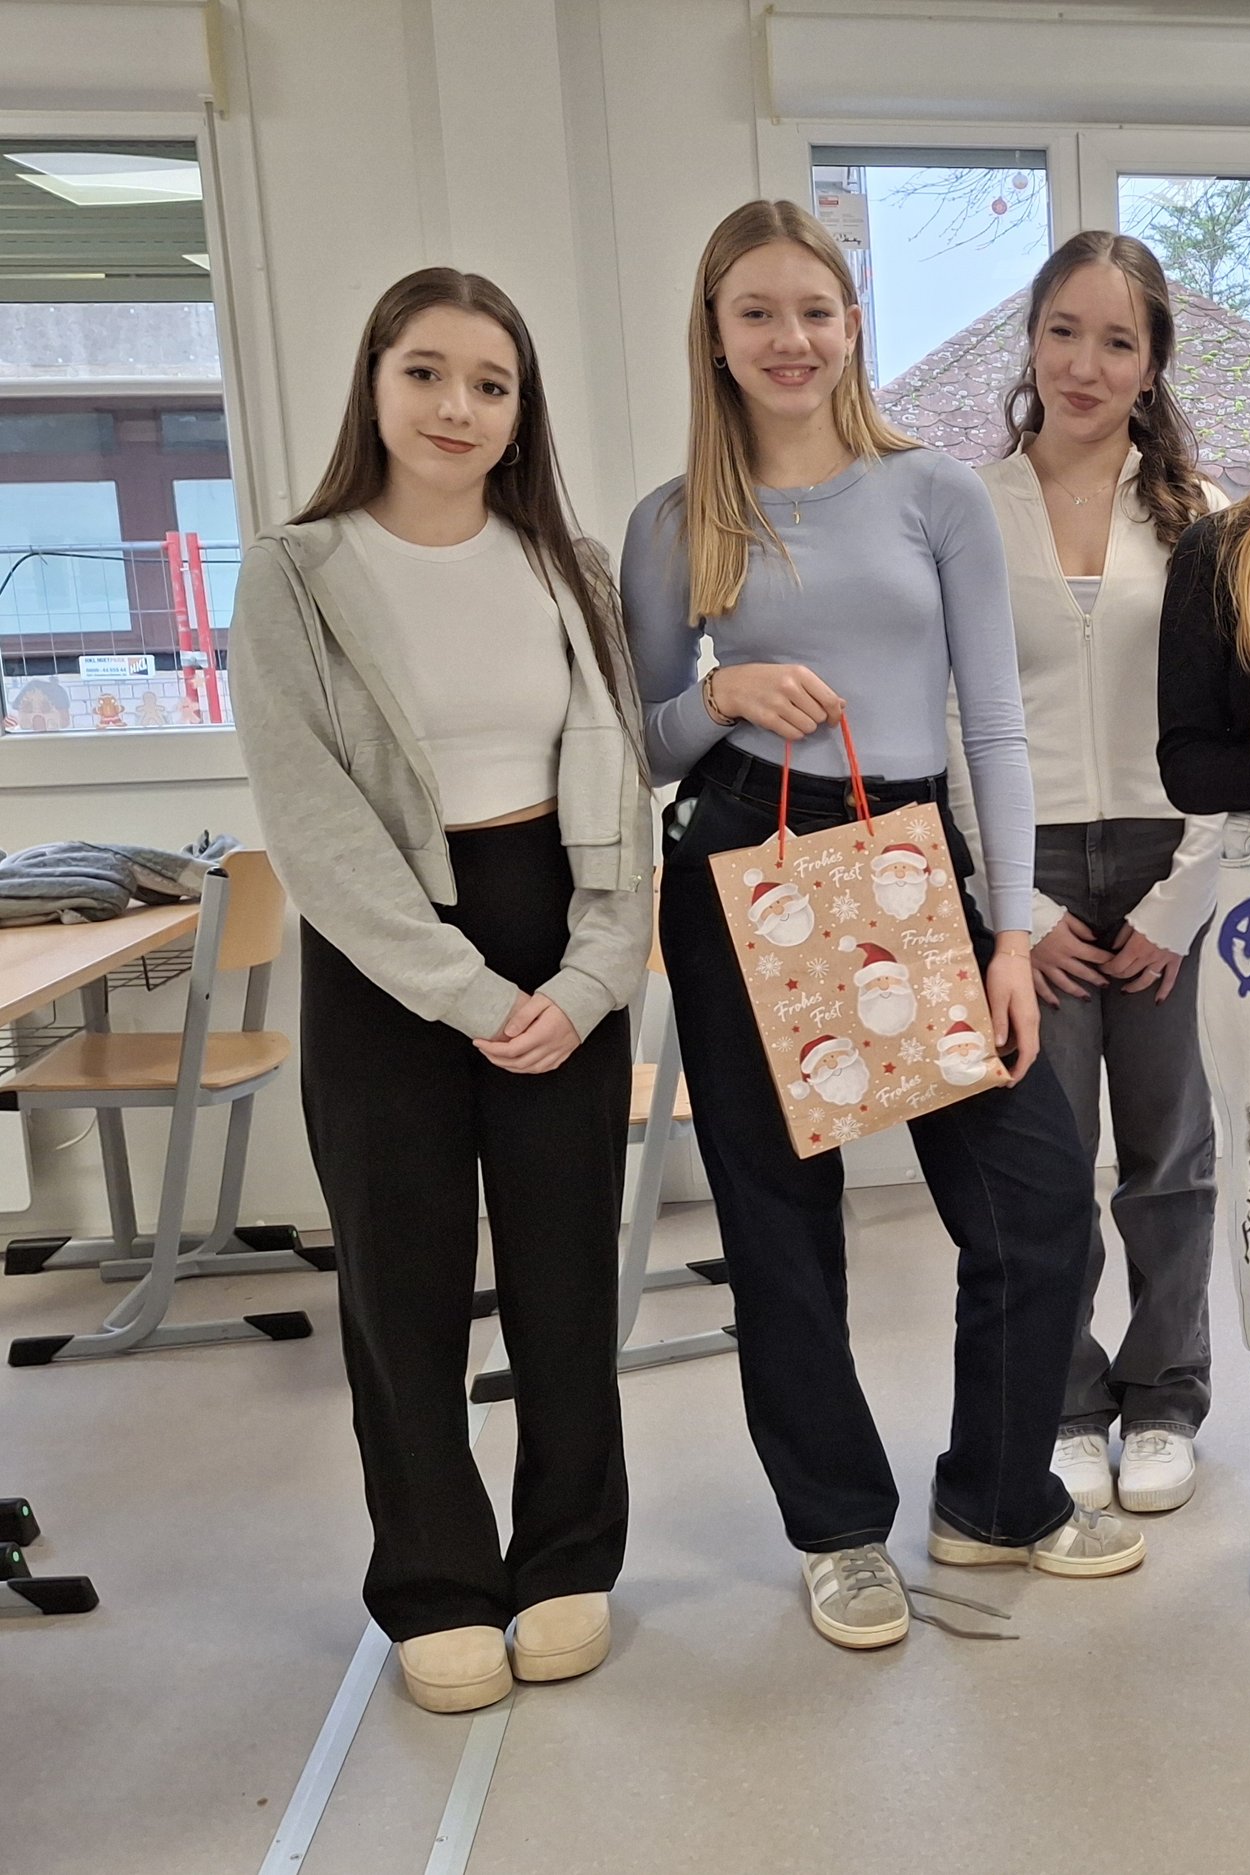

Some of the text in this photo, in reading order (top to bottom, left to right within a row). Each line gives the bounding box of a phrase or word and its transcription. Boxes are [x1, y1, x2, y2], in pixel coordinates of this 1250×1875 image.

[793, 850, 843, 878] Frohes
[829, 862, 864, 888] Fest
[901, 928, 945, 950] Frohes
[923, 949, 953, 970] Fest
[773, 992, 822, 1022] Frohes
[810, 1000, 844, 1028] Fest
[875, 1075, 921, 1107] Frohes
